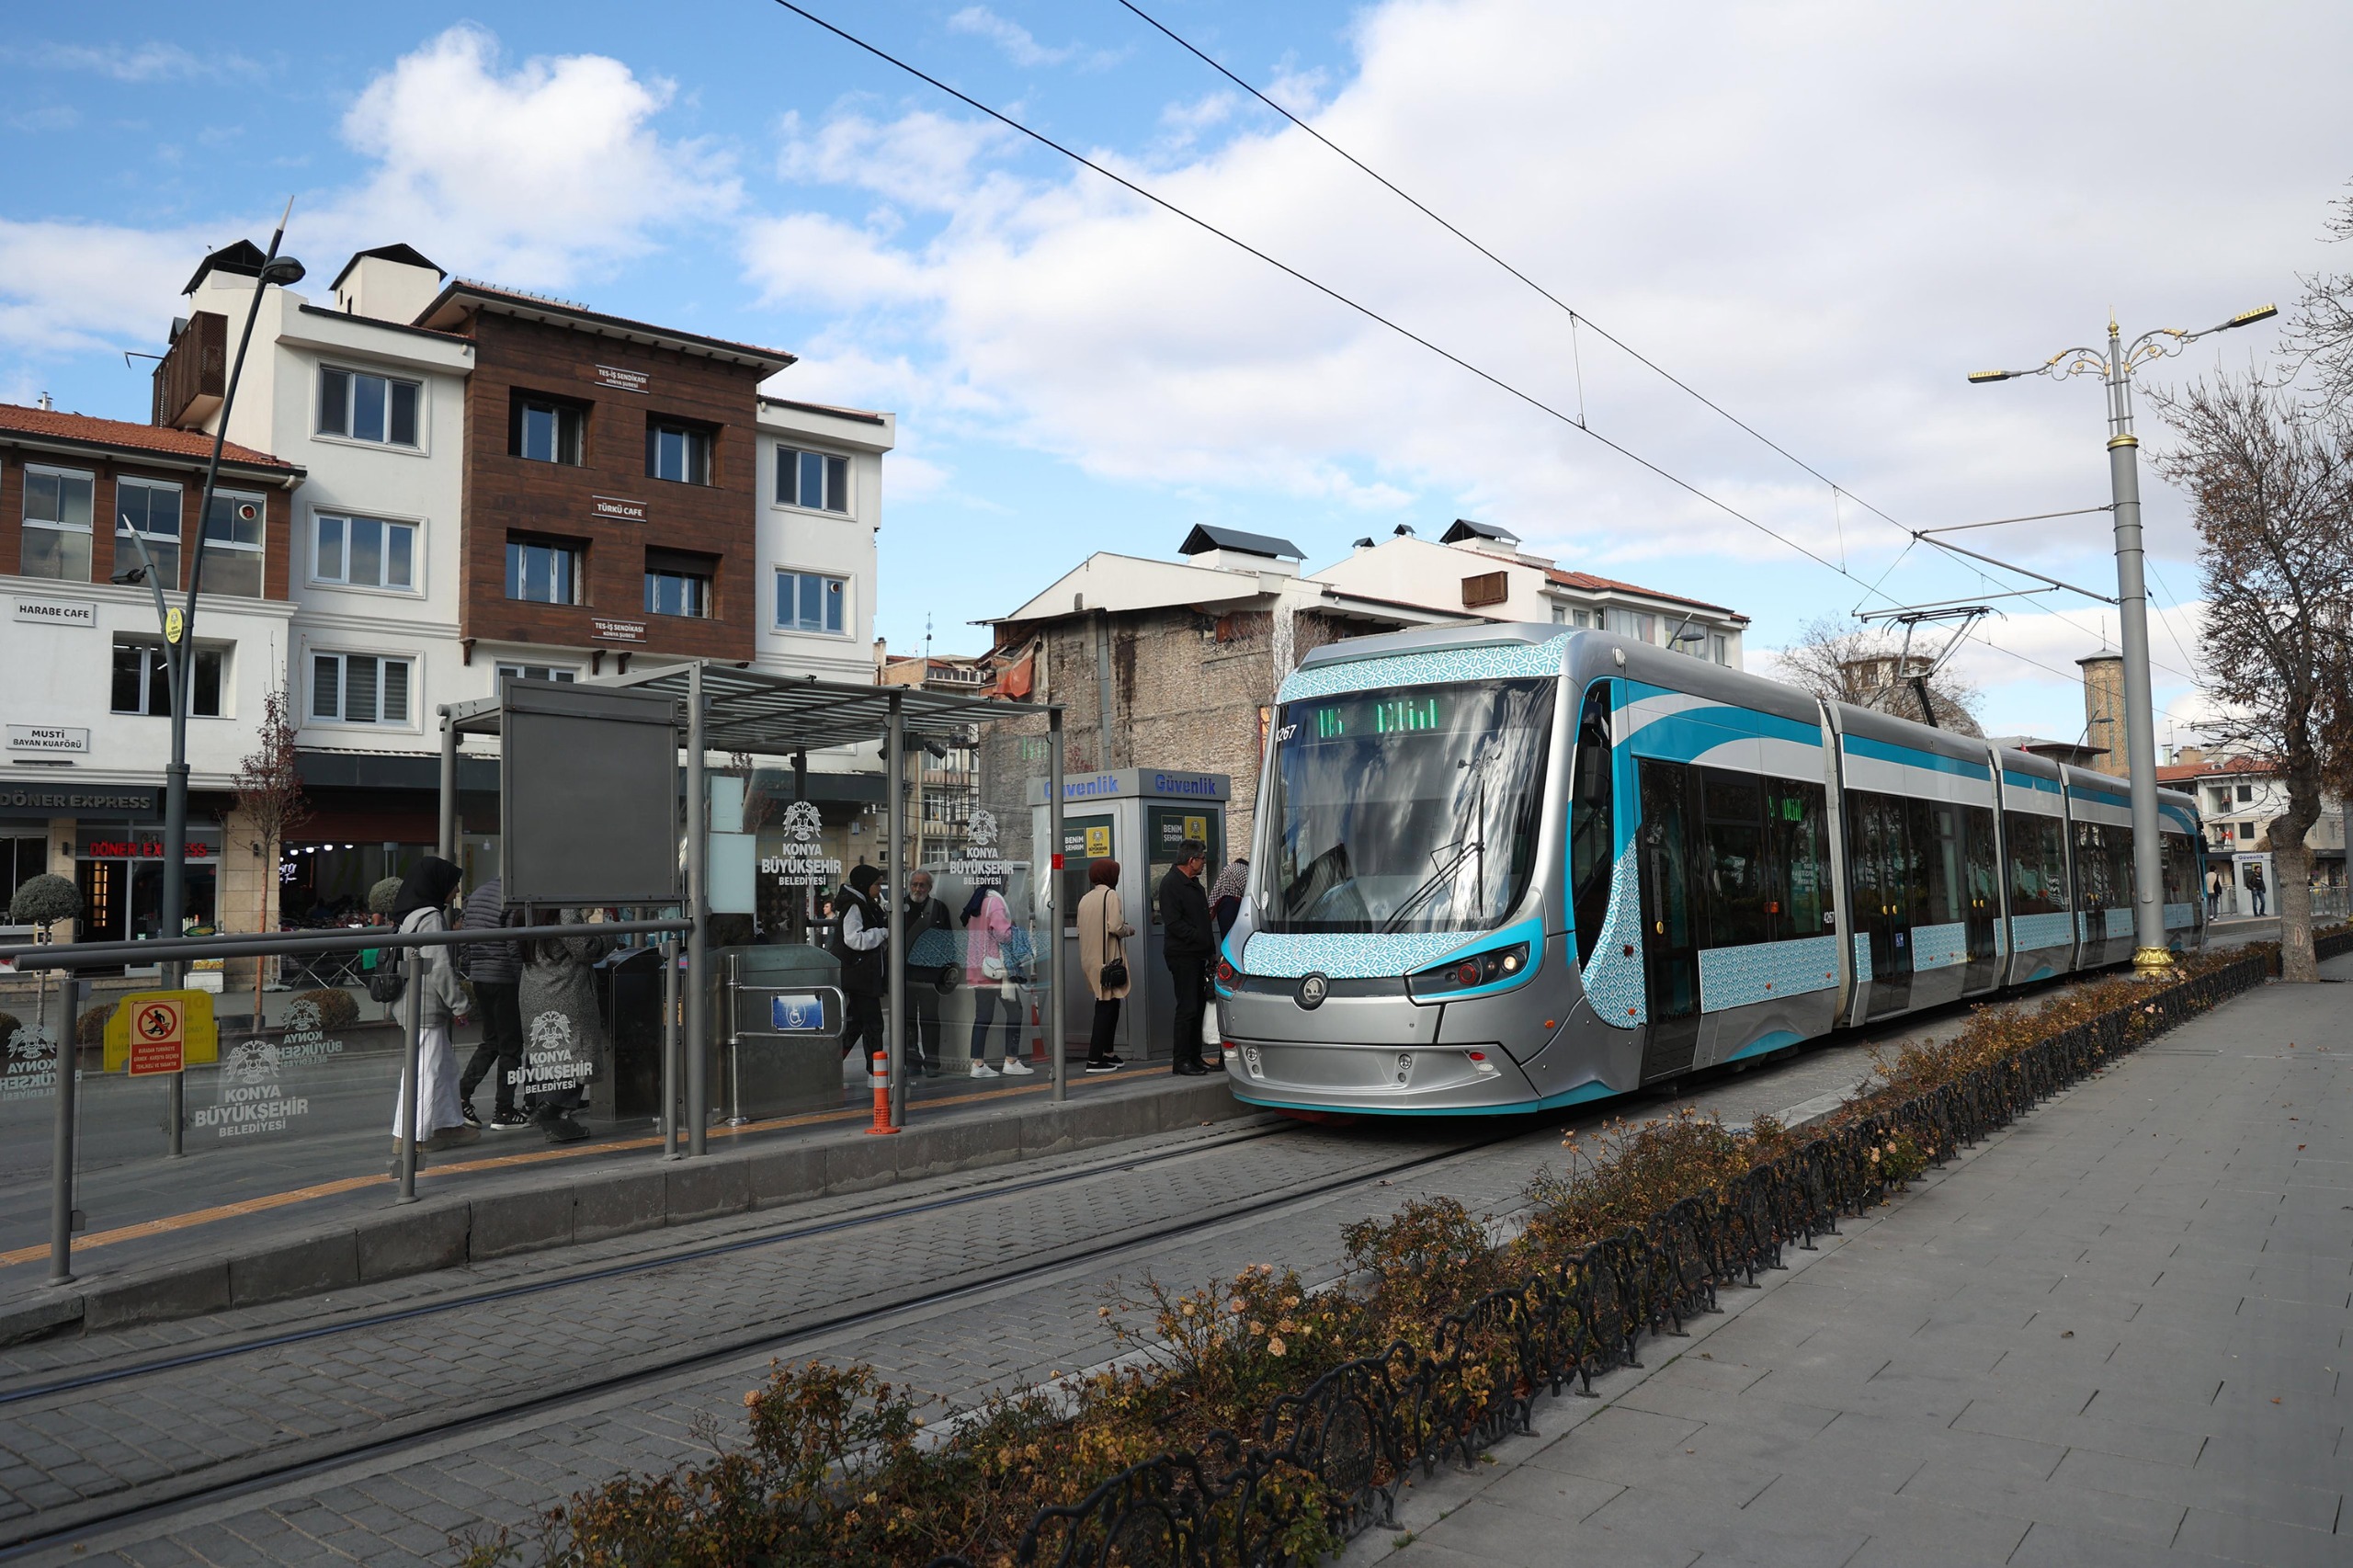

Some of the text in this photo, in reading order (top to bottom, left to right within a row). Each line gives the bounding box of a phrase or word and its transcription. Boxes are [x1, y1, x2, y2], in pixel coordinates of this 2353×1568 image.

[617, 373, 646, 383] SENDİKASI
[597, 503, 642, 517] TÜRKÜ CAFE
[19, 604, 89, 619] HARABE CAFE
[614, 624, 643, 632] SENDİKASI
[31, 729, 65, 739] MUSTİ
[13, 738, 82, 749] BAYAN KUAFÖRÜ
[1043, 775, 1120, 800] Gvenlik
[1154, 774, 1217, 796] Güvenlik
[0, 790, 151, 810] DÖNER EXPRESS
[1163, 824, 1183, 834] BENİM
[1064, 835, 1085, 845] BENİM
[90, 841, 137, 858] DÖNER
[782, 843, 823, 856] KONYA
[966, 846, 999, 858] KONYA
[1064, 844, 1085, 852] ŞEHRİM
[761, 856, 842, 876] BÜYÜKŞEHİR
[949, 858, 1014, 877] BÜYÜKŞEHİR
[779, 874, 826, 886] BELEDİYESİ
[963, 875, 1002, 885] BELEDİYESİ
[529, 1049, 572, 1065] KONYA
[507, 1060, 593, 1085] BÜYÜKŞEHİR
[525, 1077, 576, 1095] BELEDİYESİ
[224, 1085, 281, 1103] KONYA
[195, 1096, 309, 1128] BÜYÜKŞEHİR
[219, 1118, 287, 1138] BELEDİYESİ
